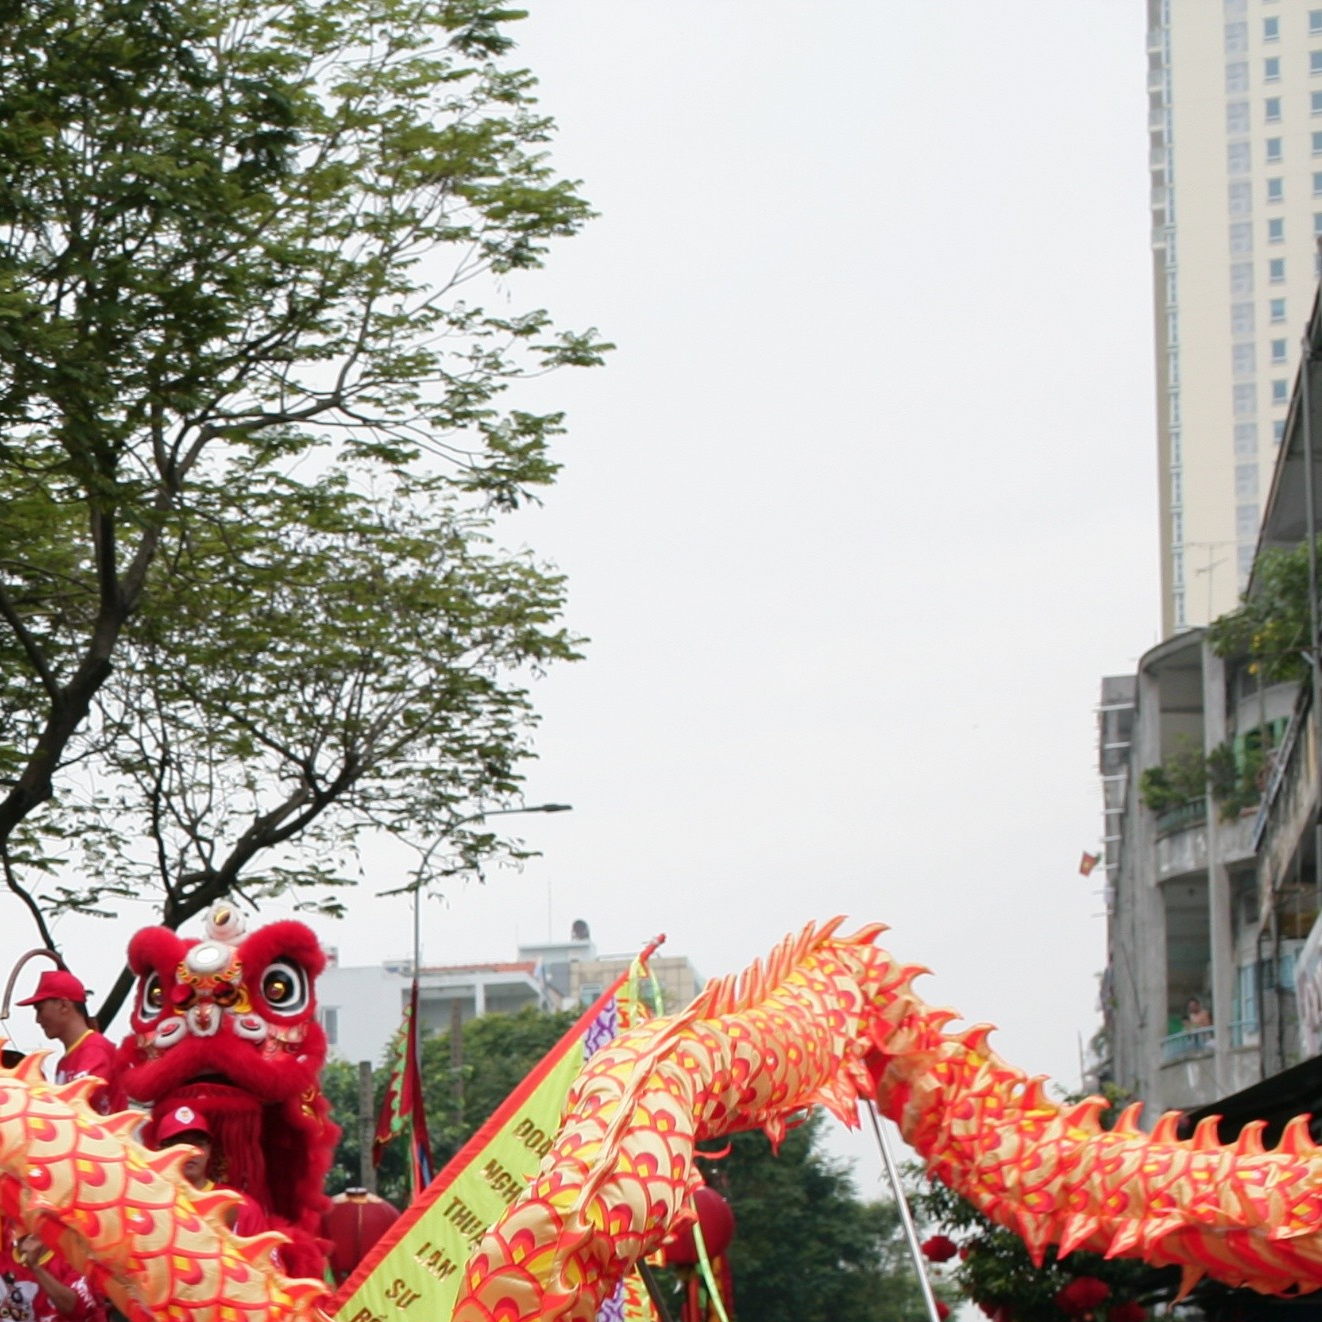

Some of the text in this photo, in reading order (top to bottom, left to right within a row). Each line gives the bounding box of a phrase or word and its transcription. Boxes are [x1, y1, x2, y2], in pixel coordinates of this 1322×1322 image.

[511, 1118, 556, 1159] ĐOÀ
[479, 1158, 524, 1204] NGH
[385, 1278, 422, 1310] SƯ
